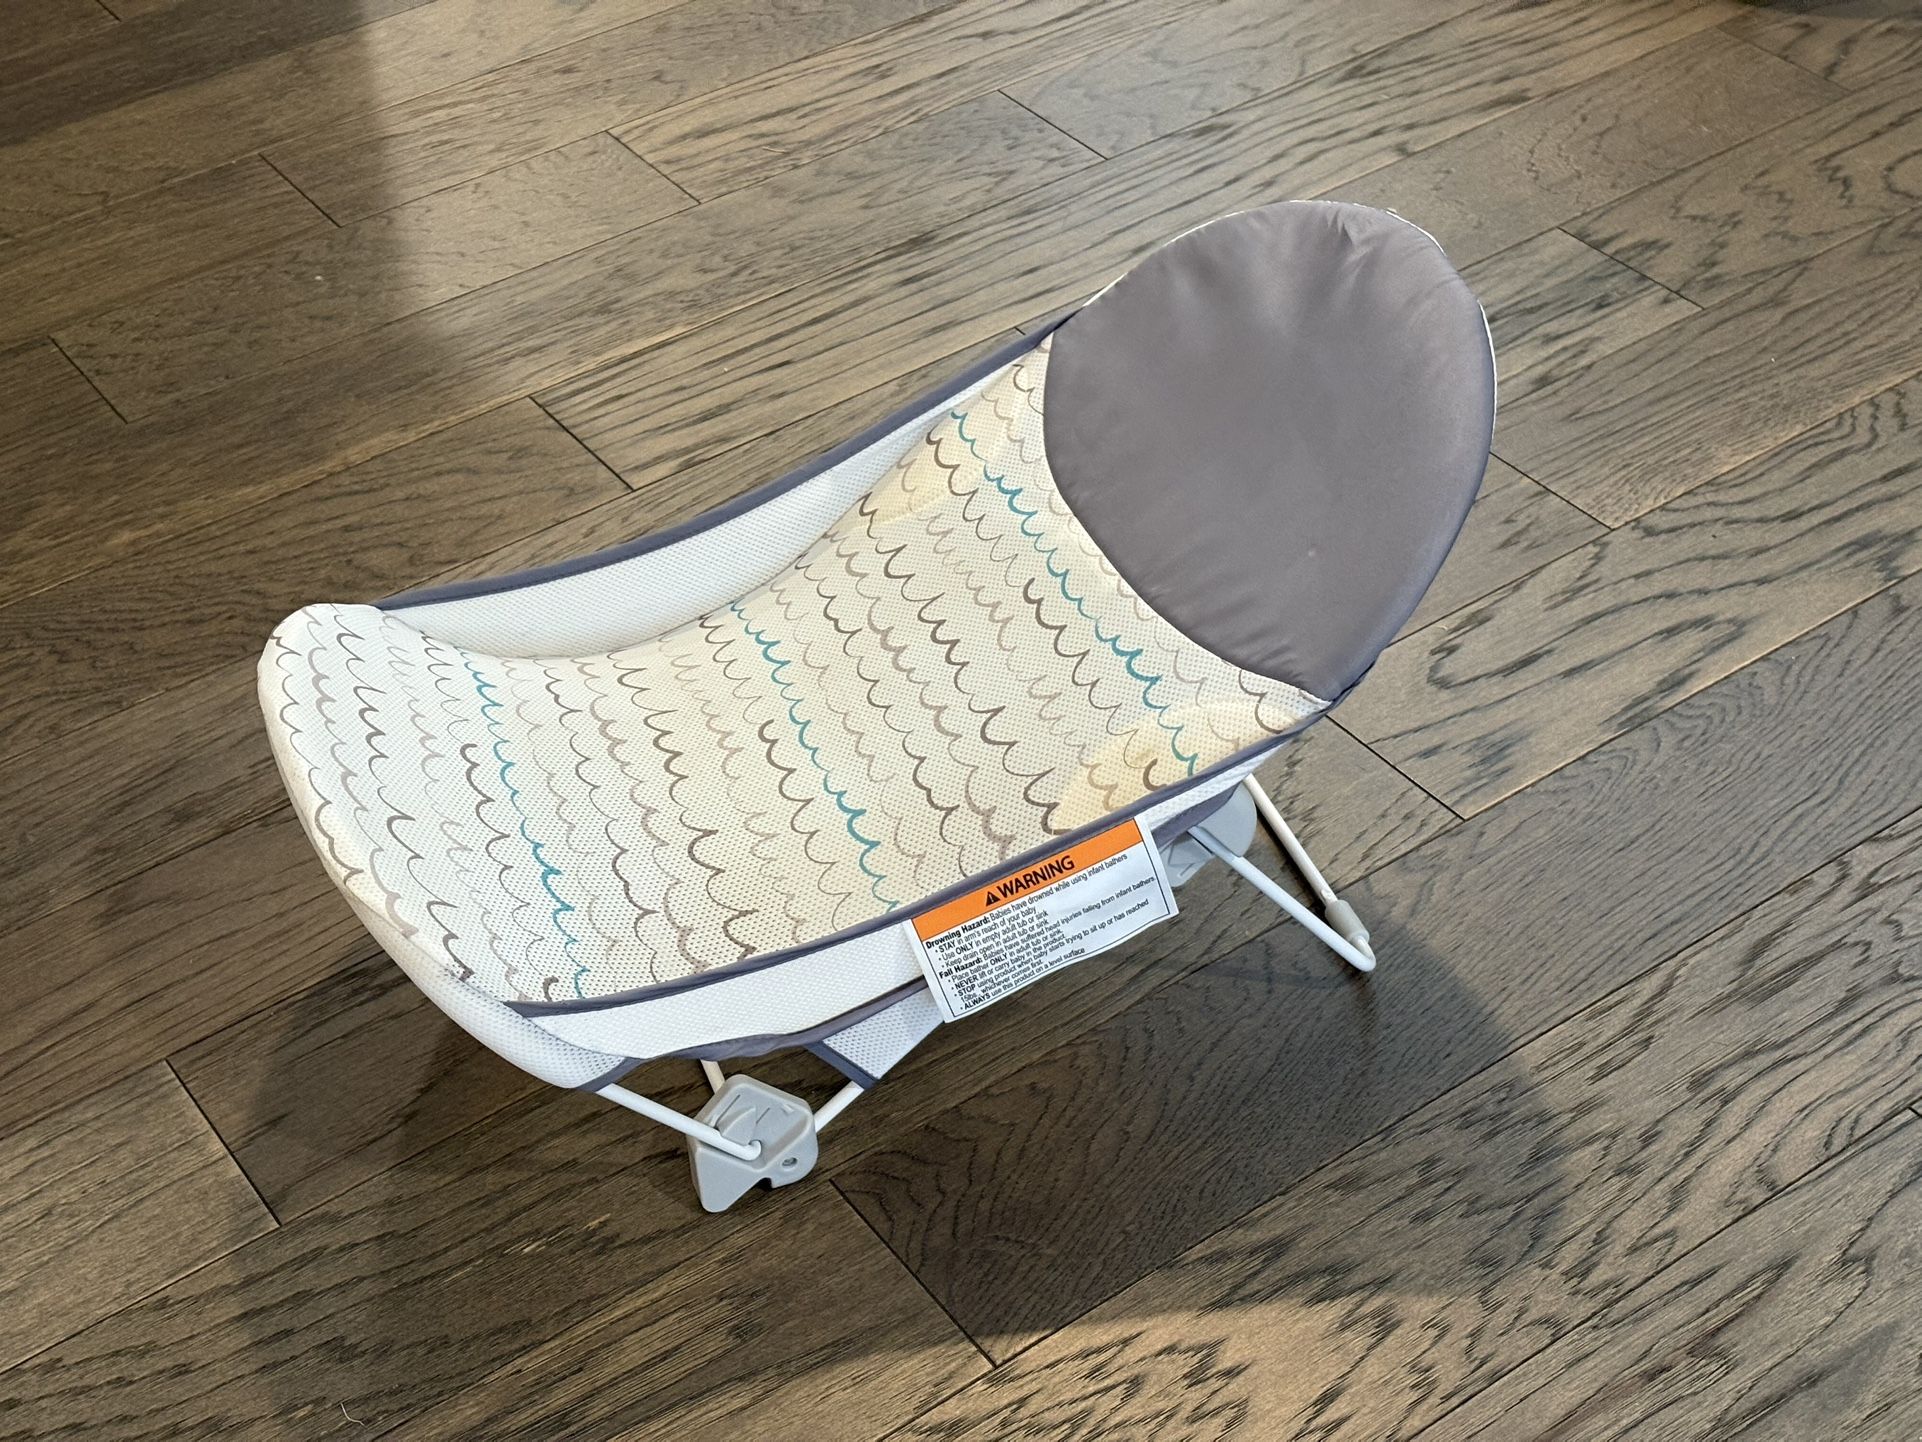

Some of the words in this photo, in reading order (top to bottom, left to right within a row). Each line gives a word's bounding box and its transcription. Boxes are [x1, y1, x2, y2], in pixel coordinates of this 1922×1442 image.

[925, 928, 961, 950] Drowning
[960, 914, 990, 934] Hazard:
[989, 906, 1012, 921] Babies
[1010, 899, 1027, 912] have
[1026, 886, 1054, 905] drowned
[1053, 879, 1070, 892] while
[1069, 871, 1088, 886] using
[1086, 862, 1105, 877] infant
[1103, 852, 1127, 868] bathers
[995, 854, 1075, 900] WARNING
[938, 939, 956, 953] STAY
[963, 929, 981, 942] arm's
[980, 921, 999, 935] reach
[1006, 912, 1021, 925] your
[1019, 905, 1037, 918] baby
[938, 967, 953, 979] Fall
[953, 955, 983, 973] Hazard:
[982, 946, 1004, 961] Babies
[1003, 939, 1020, 951] have
[1019, 927, 1045, 944] suffered
[1044, 919, 1060, 932] head
[1059, 909, 1082, 925] injuries
[1081, 901, 1101, 914] falling
[1100, 894, 1115, 906] from
[1114, 885, 1132, 898] infant
[941, 950, 955, 961] Use
[954, 940, 974, 955] ONLY
[981, 930, 1001, 945] empty
[1000, 923, 1017, 935] adult
[1016, 918, 1028, 928] tub
[1033, 908, 1048, 920] sink
[944, 956, 962, 968] Keep
[961, 949, 978, 961] drain
[978, 942, 995, 955] open
[1001, 931, 1017, 944] adult
[1016, 926, 1028, 937] tub
[1034, 917, 1049, 929] sink
[957, 983, 976, 996] STOP
[976, 975, 994, 988] using
[993, 964, 1017, 981] product
[1016, 956, 1033, 968] when
[1032, 949, 1048, 961] baby
[1048, 940, 1065, 952] starts
[1064, 932, 1083, 945] trying
[1089, 924, 1098, 933] sit
[1113, 911, 1125, 921] has
[1124, 897, 1149, 916] reached
[950, 970, 969, 983] Place
[968, 961, 989, 975] bather
[989, 952, 1008, 966] ONLY
[1015, 942, 1031, 954] adult
[1030, 937, 1041, 947] tub
[954, 974, 979, 990] NEVER
[977, 970, 987, 979] lift
[993, 960, 1010, 972] carry
[1009, 953, 1025, 965] baby
[1031, 944, 1042, 953] the
[963, 992, 991, 1010] ALWAYS
[990, 987, 1002, 996] use
[1001, 981, 1013, 990] this
[1013, 969, 1036, 986] product
[1047, 955, 1063, 966] level
[1062, 946, 1085, 962] surface
[980, 975, 1010, 993] whichever
[1010, 965, 1030, 978] comes
